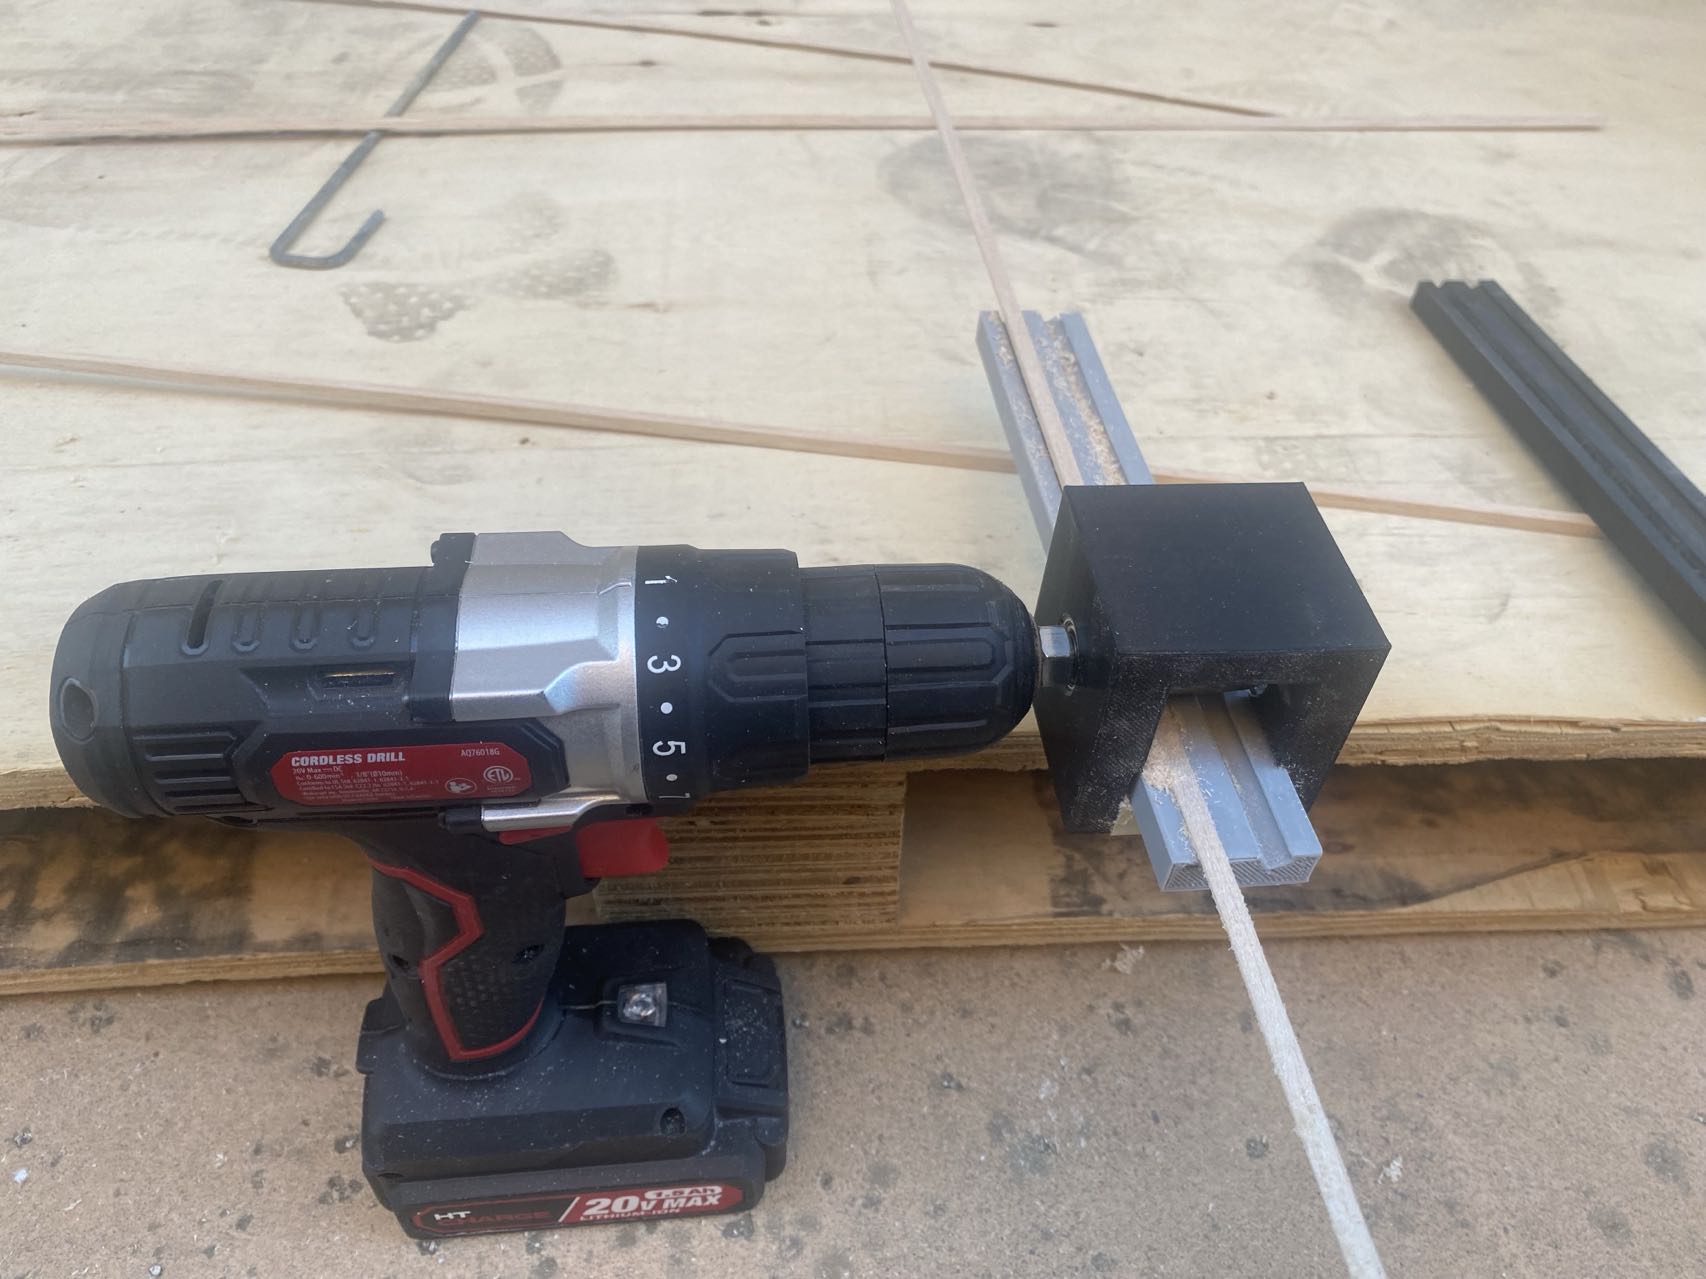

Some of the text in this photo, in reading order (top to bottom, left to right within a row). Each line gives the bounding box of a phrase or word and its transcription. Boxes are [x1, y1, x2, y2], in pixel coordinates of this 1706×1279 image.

[644, 575, 678, 585] 1
[647, 654, 681, 674] 3
[652, 740, 686, 756] 5
[291, 752, 406, 767] CORDLESS DRILL
[662, 1194, 723, 1210] MAX
[434, 1210, 471, 1220] HT
